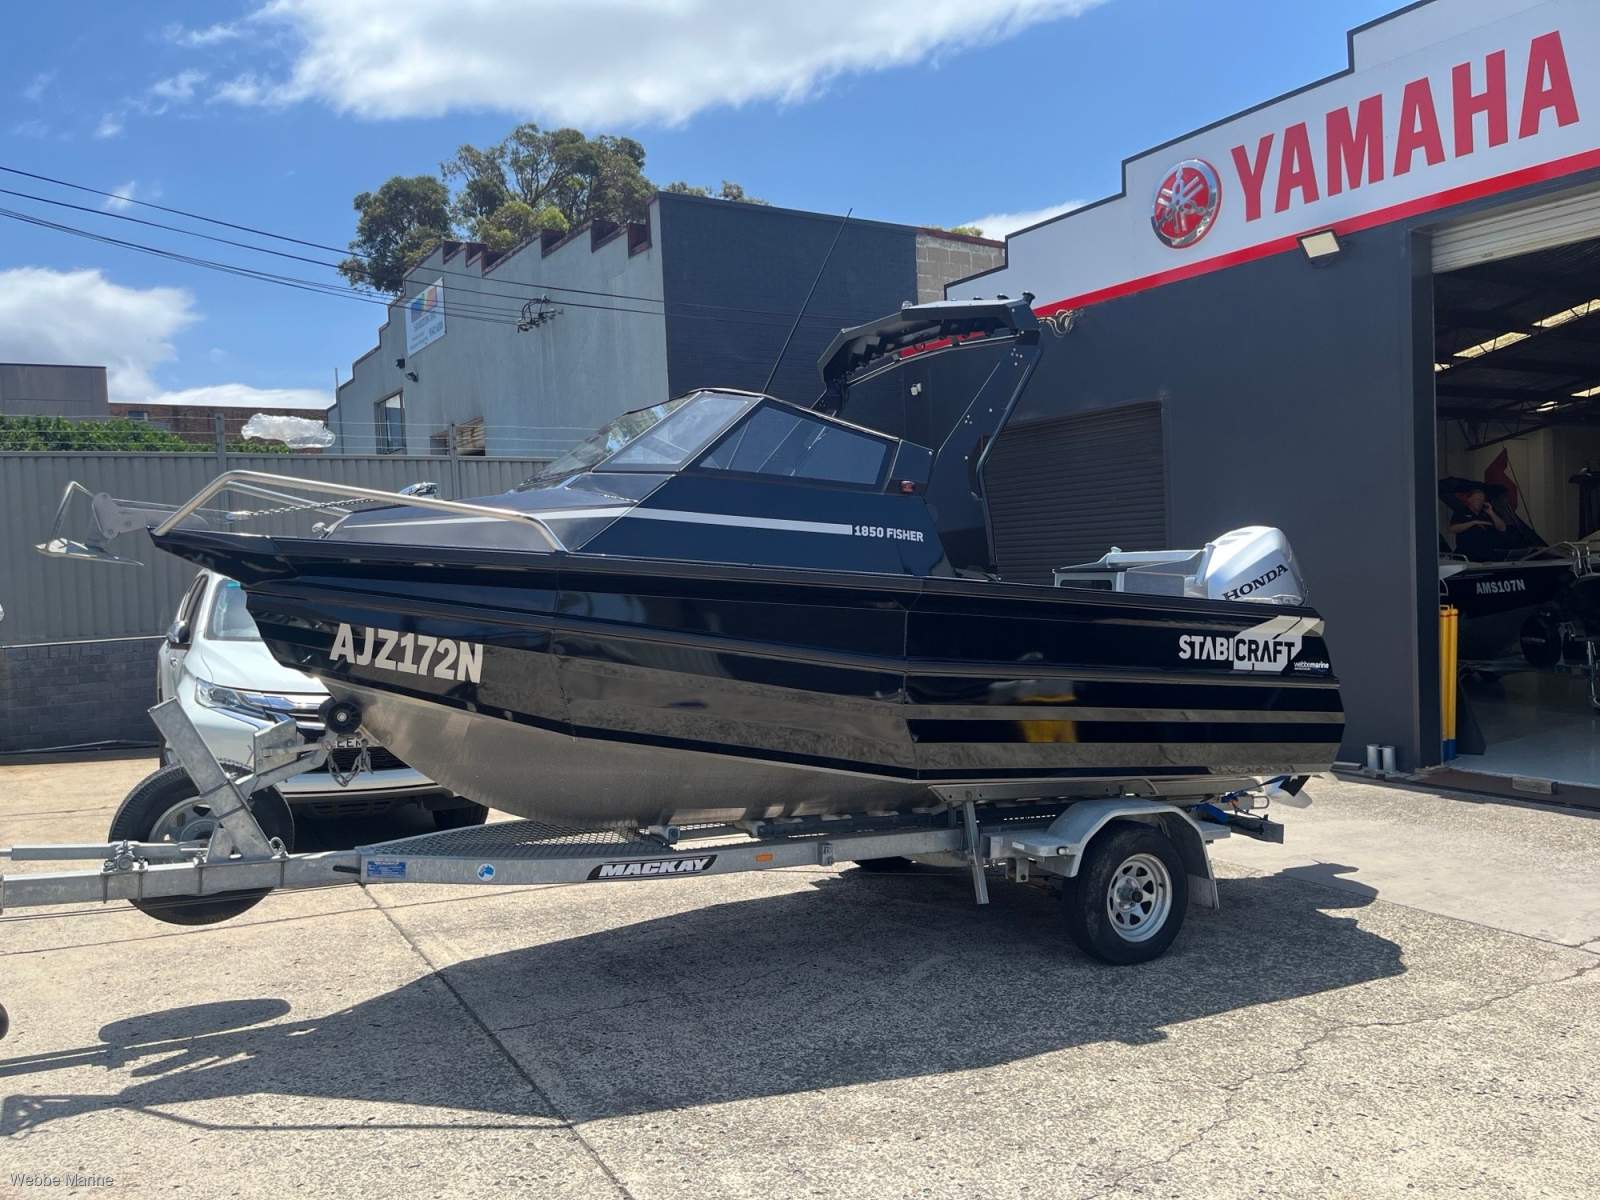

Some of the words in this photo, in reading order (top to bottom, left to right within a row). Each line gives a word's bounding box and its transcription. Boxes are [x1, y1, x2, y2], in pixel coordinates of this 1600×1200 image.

[1231, 30, 1579, 221] YAMAHA
[854, 525, 884, 538] 1850
[886, 527, 924, 542] FISHER
[1222, 564, 1288, 600] HONDA
[1476, 579, 1526, 594] AMS107N
[329, 623, 483, 684] AJZ172N
[1178, 634, 1295, 663] STABICRAFT
[598, 858, 709, 876] MACKAY
